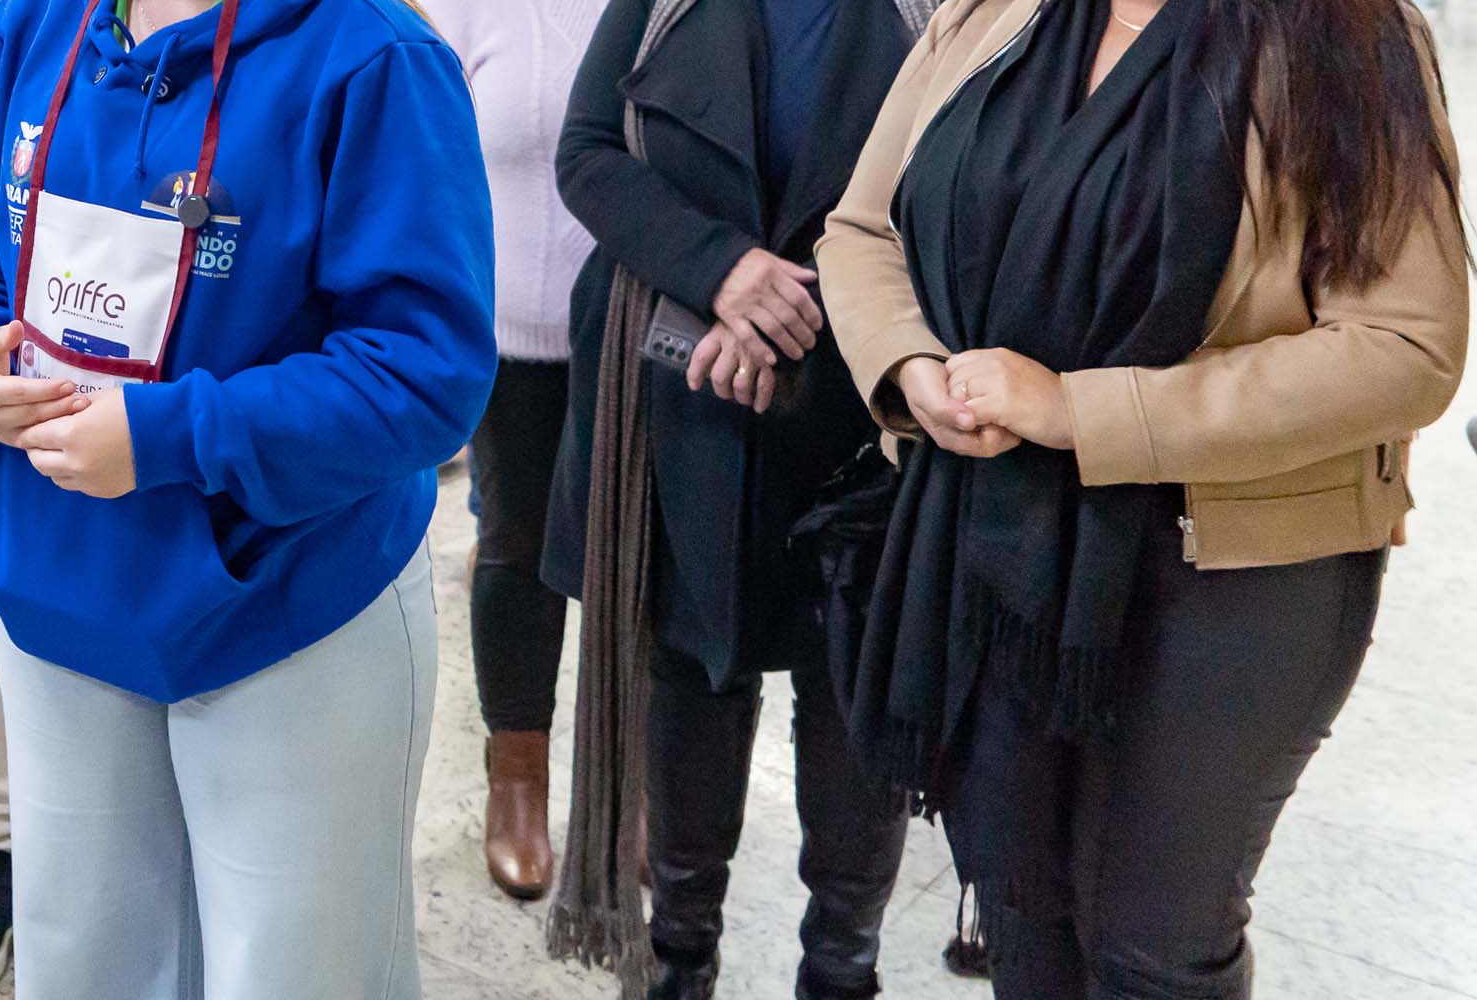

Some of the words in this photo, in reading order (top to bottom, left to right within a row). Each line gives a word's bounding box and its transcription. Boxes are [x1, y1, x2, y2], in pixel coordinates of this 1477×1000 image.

[5, 183, 30, 206] RAN
[197, 235, 237, 254] NDO
[47, 271, 126, 319] griffe
